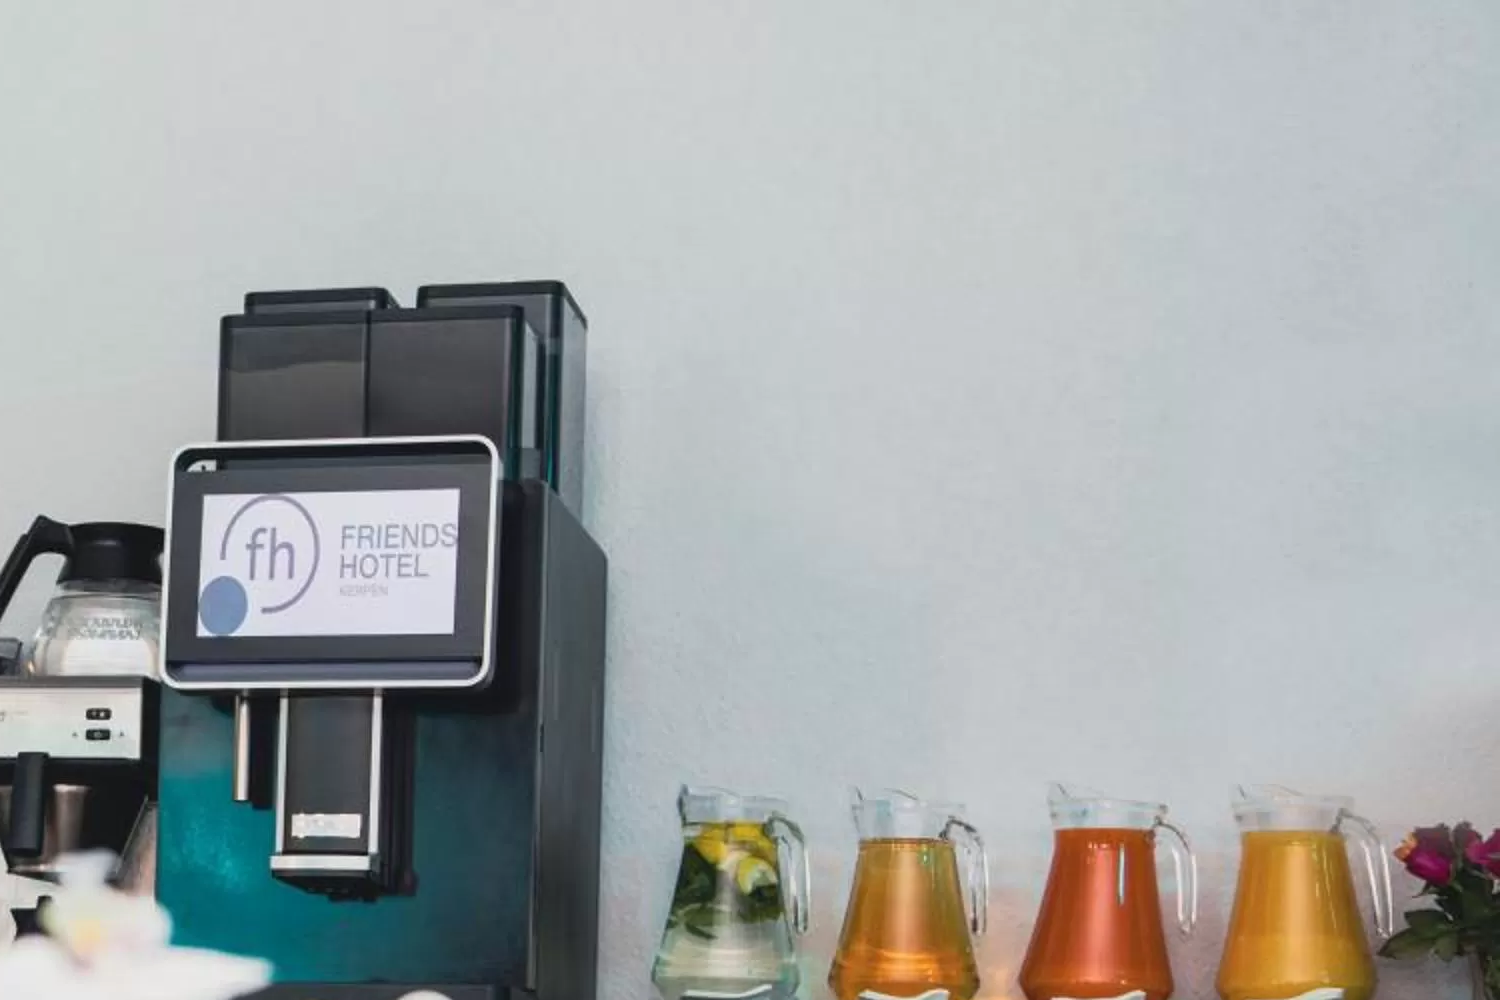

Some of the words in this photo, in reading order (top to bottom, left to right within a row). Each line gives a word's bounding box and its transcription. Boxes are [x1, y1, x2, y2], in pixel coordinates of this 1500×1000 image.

[340, 523, 457, 549] FRIENDS
[245, 527, 295, 580] fh
[339, 553, 430, 578] HOTEL
